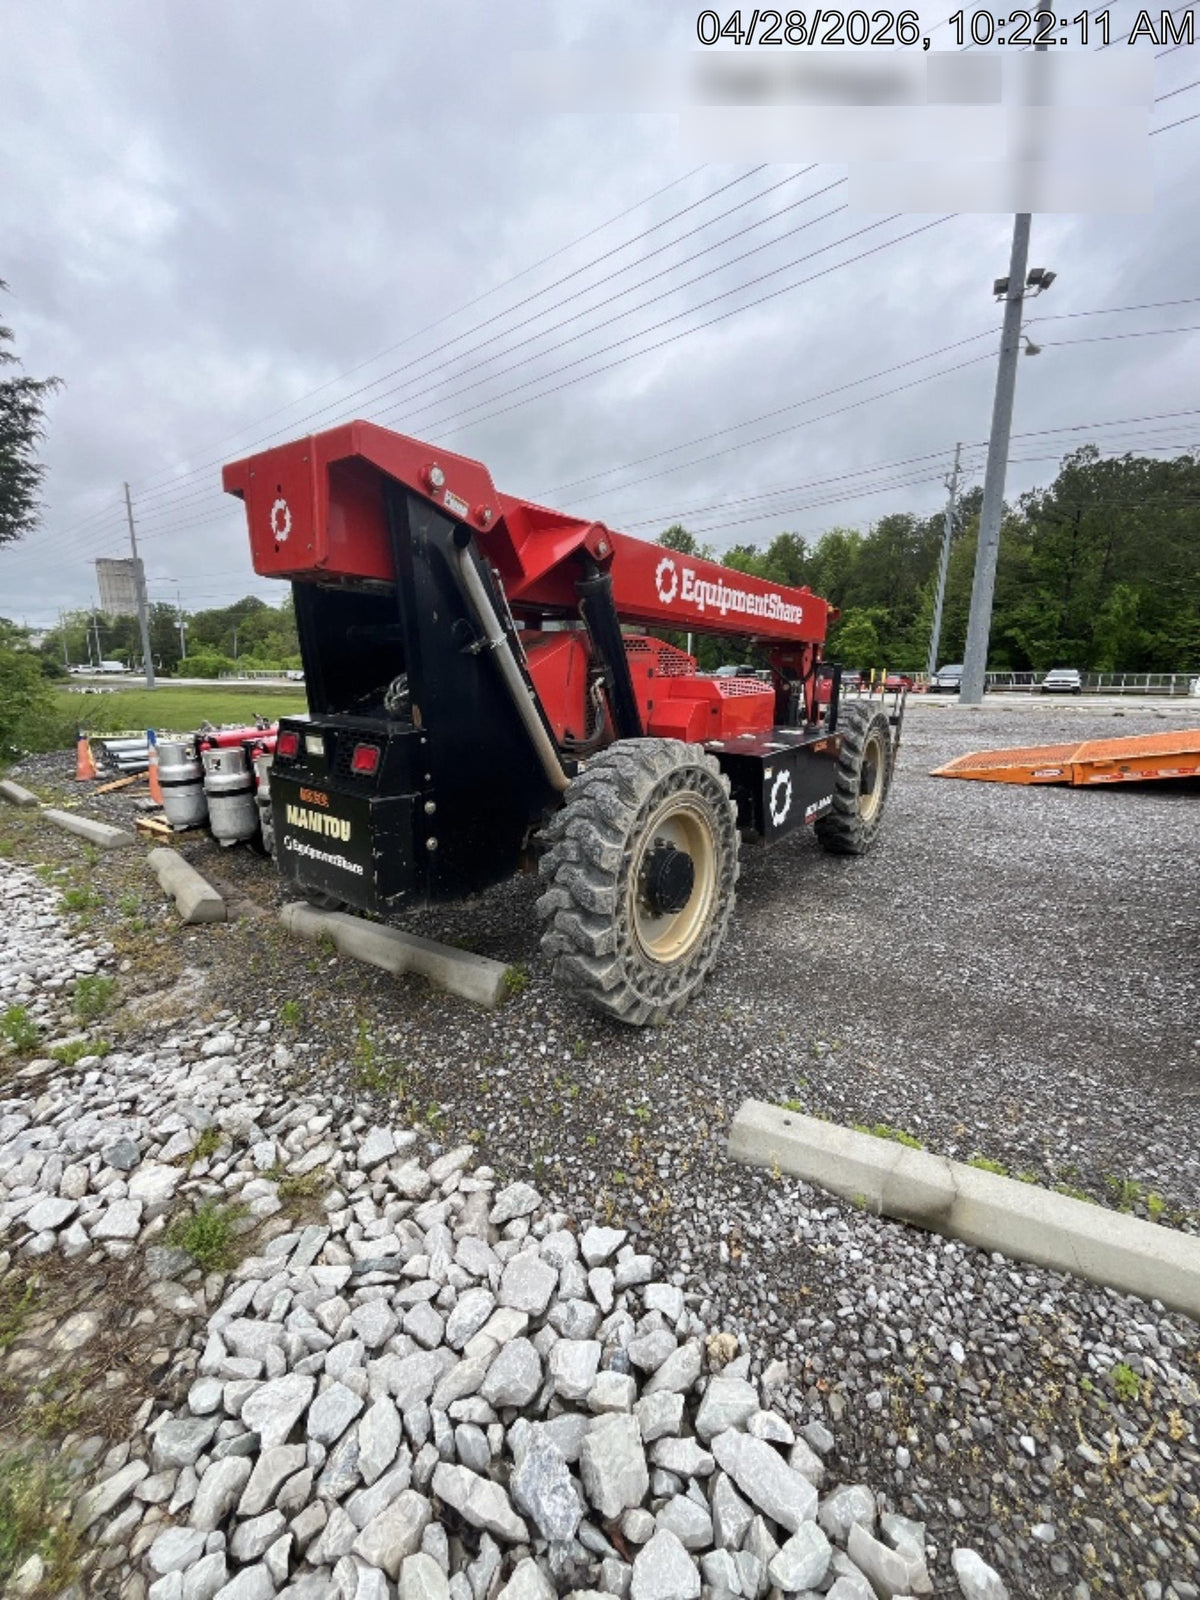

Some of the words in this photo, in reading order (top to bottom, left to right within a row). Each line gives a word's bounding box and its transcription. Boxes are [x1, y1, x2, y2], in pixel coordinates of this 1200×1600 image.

[680, 567, 804, 625] EquipmentShare
[285, 803, 351, 842] MANITOU
[292, 837, 364, 876] EquipmentShare
